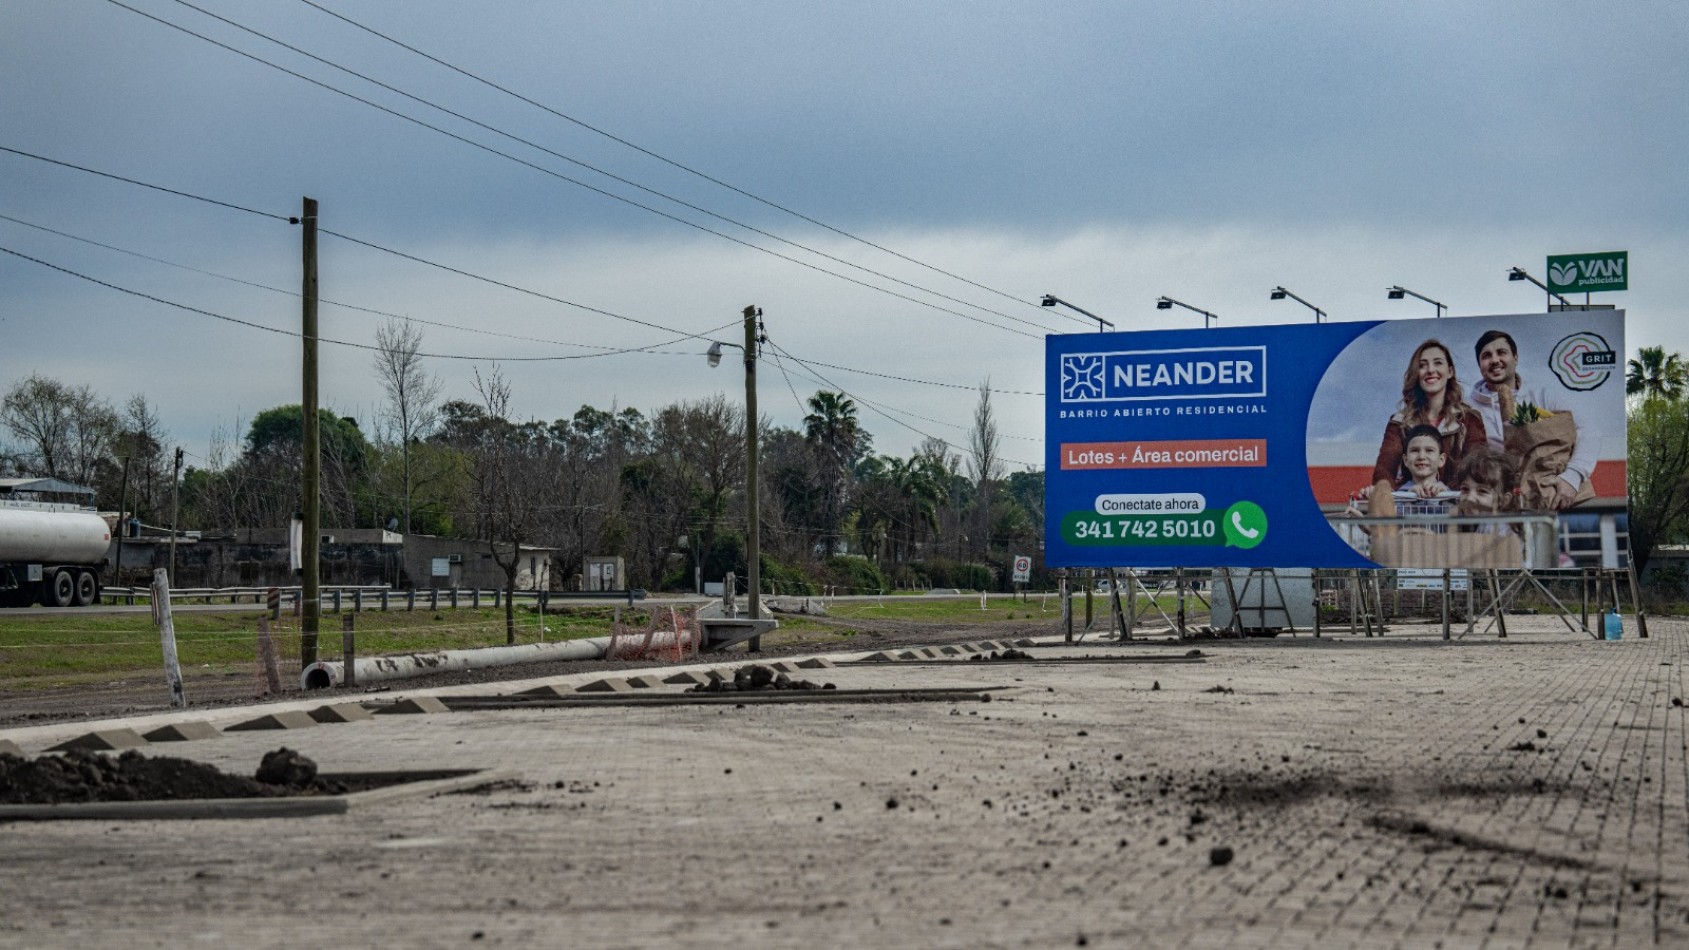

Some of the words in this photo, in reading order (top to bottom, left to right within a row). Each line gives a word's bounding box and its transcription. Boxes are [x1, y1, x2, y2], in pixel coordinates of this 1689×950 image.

[1578, 258, 1624, 277] VAN
[1578, 276, 1624, 286] publicidad
[1585, 354, 1612, 363] GRIT
[1114, 360, 1254, 388] NEANDER
[1060, 409, 1108, 419] BARRIO
[1113, 407, 1171, 417] ABIERTO
[1176, 404, 1267, 415] RESIDENCIAL
[1068, 450, 1115, 465] Lotes
[1119, 453, 1128, 463] +
[1132, 445, 1171, 463] Área
[1175, 446, 1258, 463] comercial
[1101, 499, 1162, 511] Conectate
[1164, 498, 1199, 510] ahora
[1075, 521, 1114, 538] 341
[1119, 520, 1158, 538] 742
[1162, 519, 1216, 538] 5010
